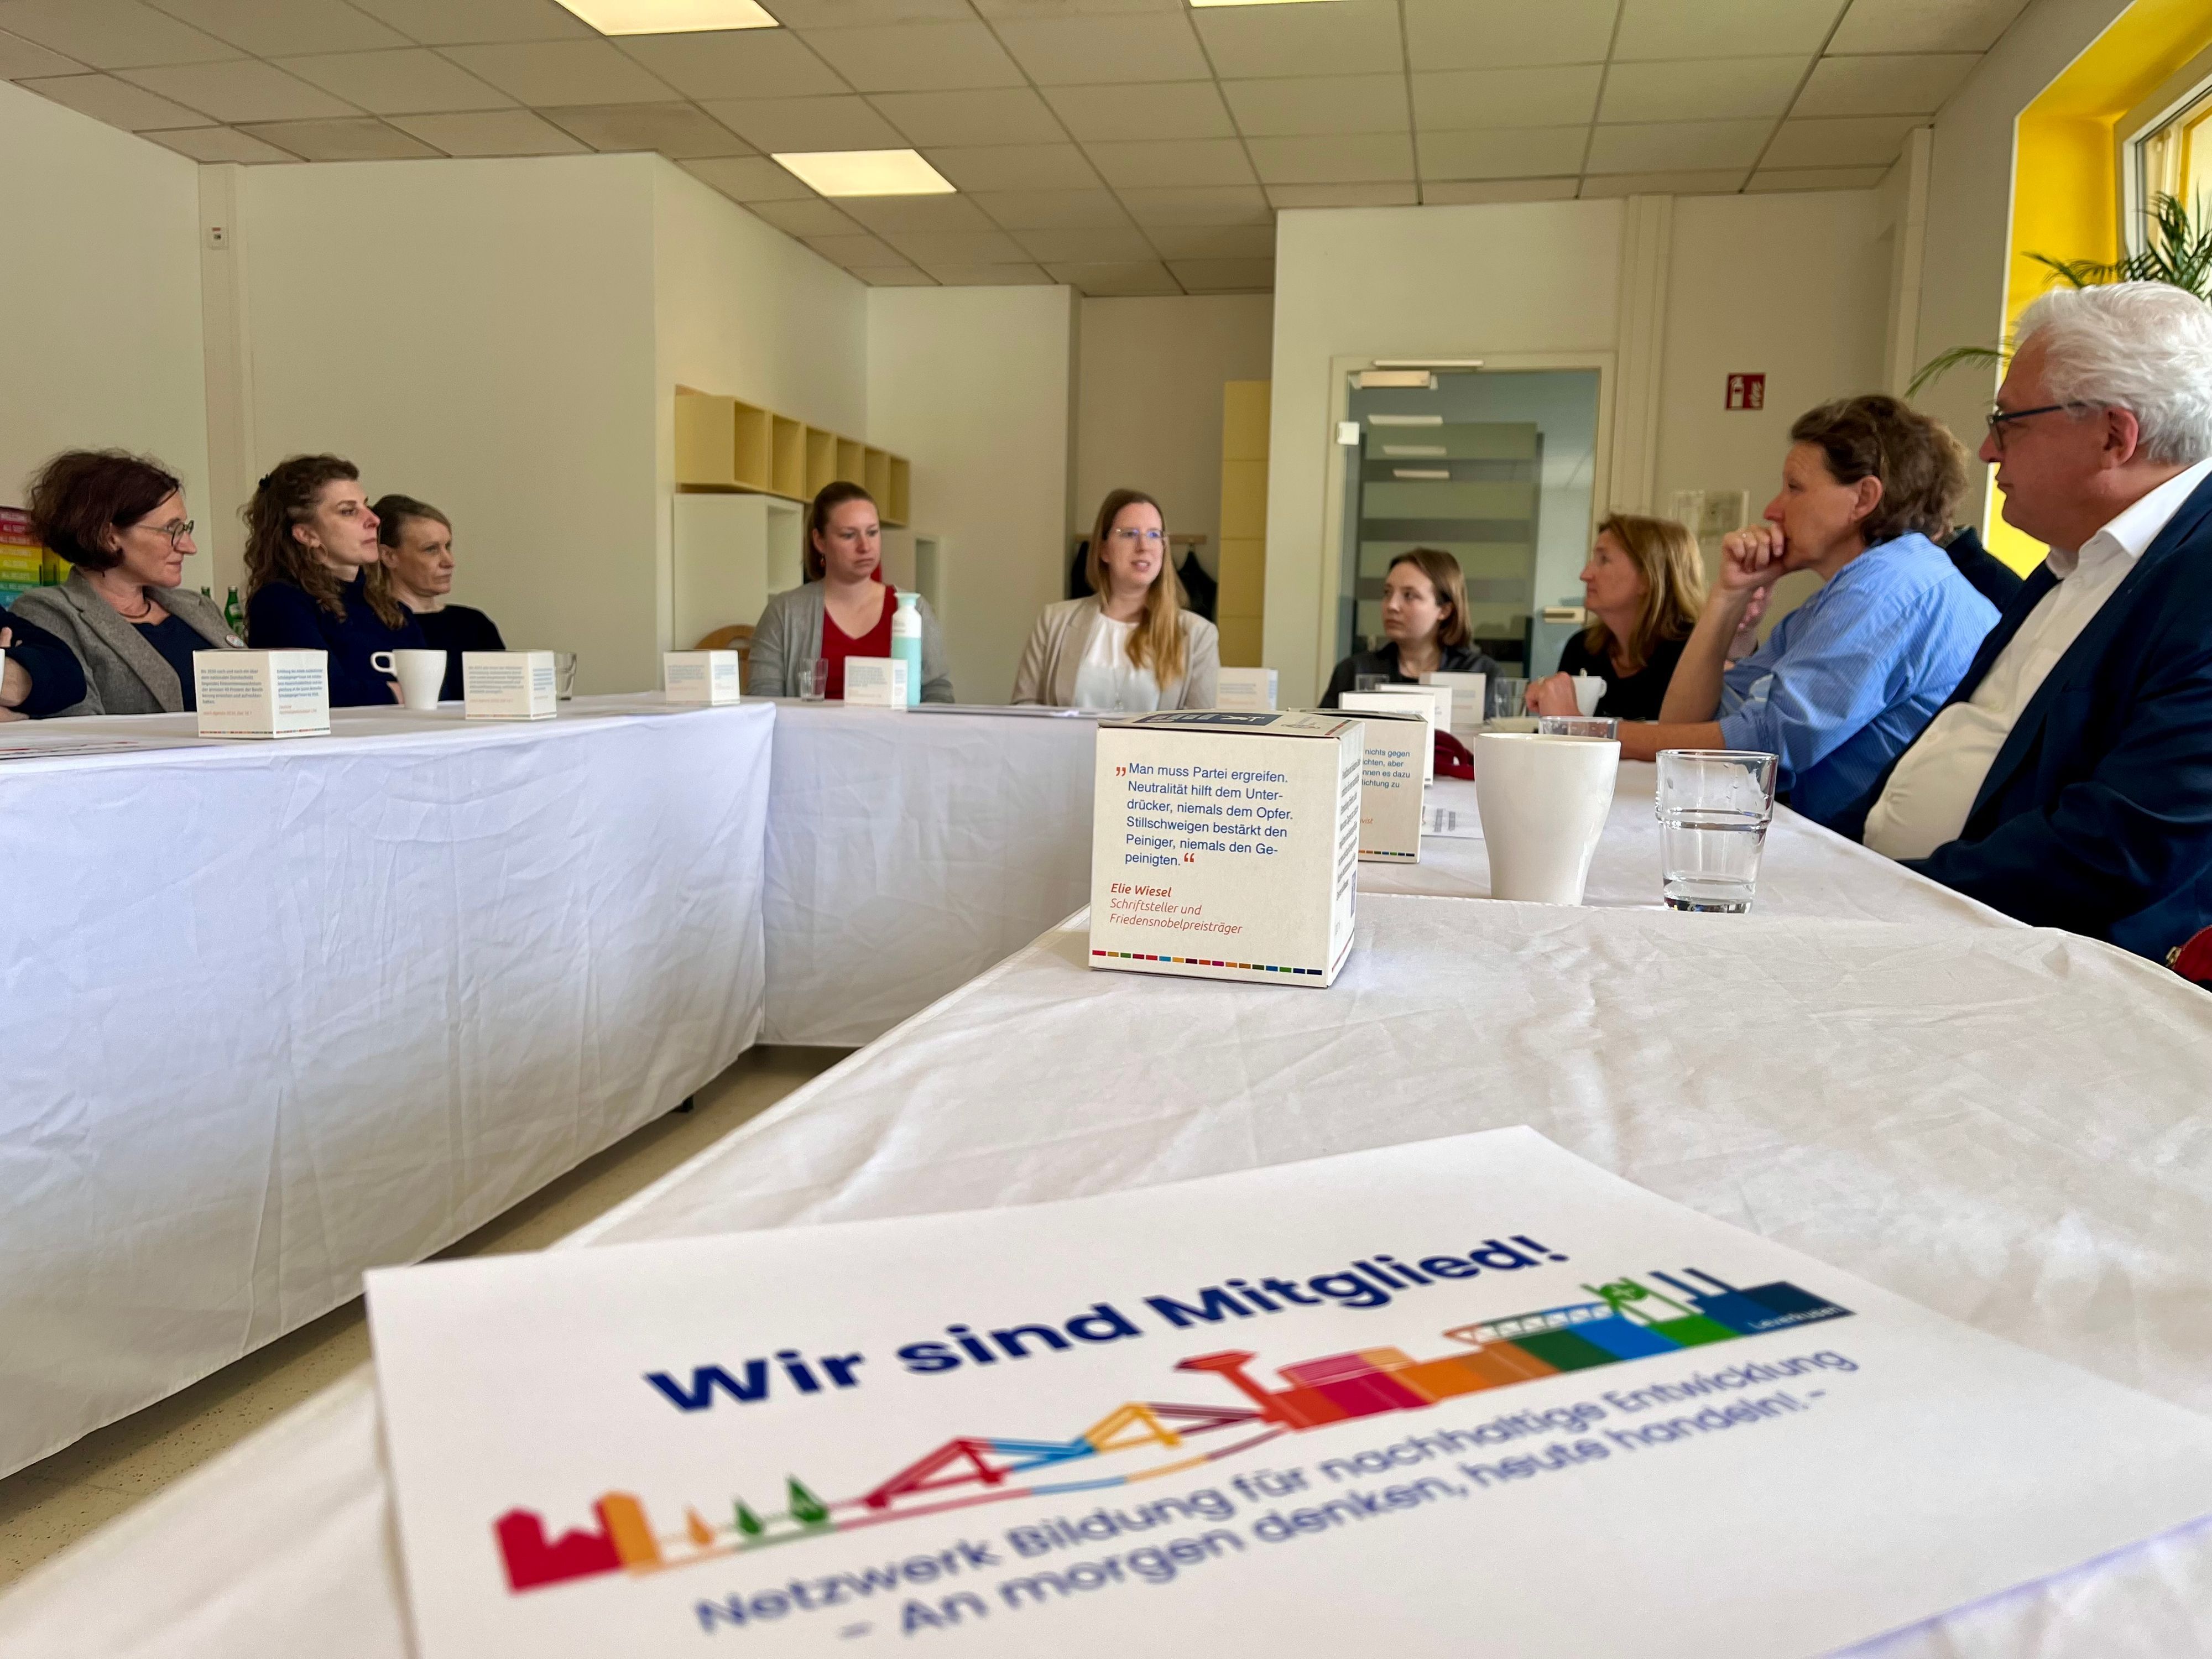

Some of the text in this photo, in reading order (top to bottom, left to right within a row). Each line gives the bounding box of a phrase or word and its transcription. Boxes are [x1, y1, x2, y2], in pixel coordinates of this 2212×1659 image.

[1158, 766, 1189, 777] muss
[1193, 767, 1227, 780] Partei
[1232, 770, 1288, 783] ergreifen.
[1129, 780, 1283, 801] Neutralität hilft dem Unter-
[1127, 799, 1293, 821] drücker, niemals dem Opfer.
[1126, 816, 1287, 838] Stillschweigen bestärkt den
[1126, 834, 1278, 854] Peiniger, niemals den Ge-
[1110, 883, 1172, 898] Elie Wiesel
[1110, 898, 1202, 915] Schriftsteller und
[1109, 913, 1243, 935] Friedensnobelpreisträger
[645, 1233, 1569, 1411] Wir sind Mitglied!
[696, 1350, 1859, 1634] Netzwerk Bildung für nachhaltige Entwicklung
[902, 1592, 989, 1637] An
[999, 1529, 1245, 1608] morgen
[1253, 1477, 1468, 1542] denken,
[1459, 1439, 1609, 1486] heute
